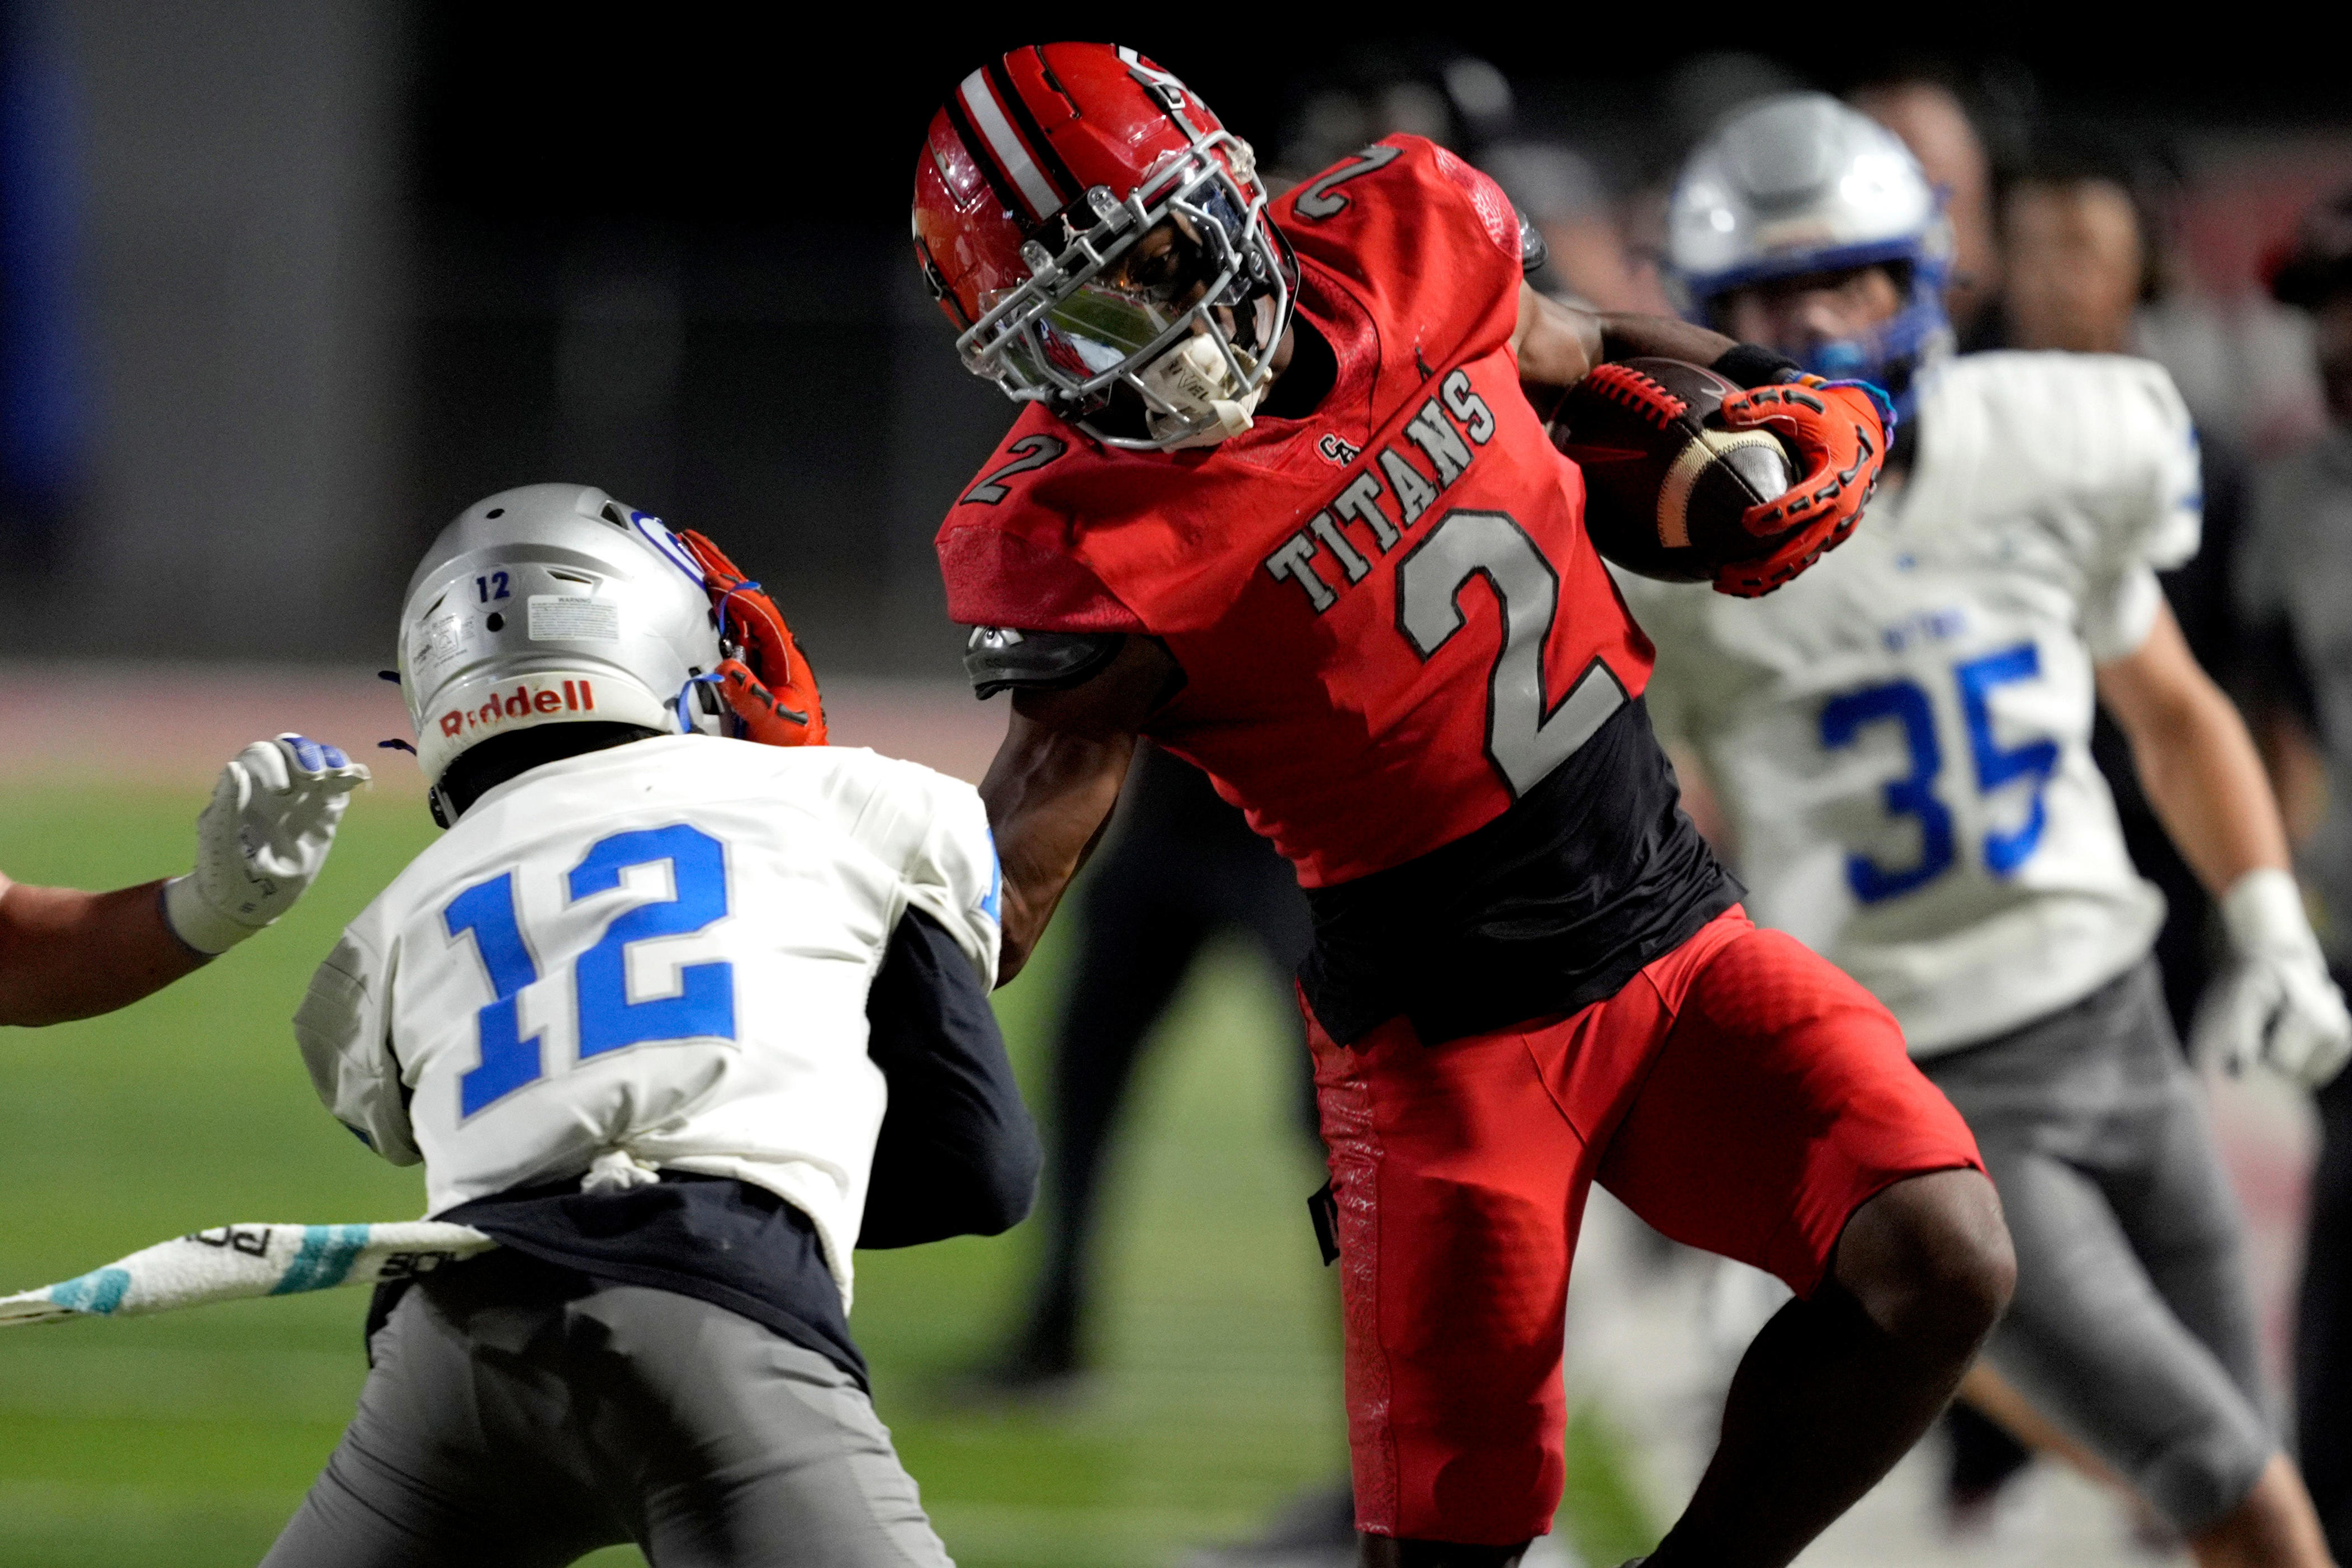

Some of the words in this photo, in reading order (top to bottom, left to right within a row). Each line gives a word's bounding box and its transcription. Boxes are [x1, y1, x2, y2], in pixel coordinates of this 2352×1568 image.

[1294, 143, 1405, 221] 2
[476, 571, 510, 603] 12
[959, 434, 1068, 506] 2
[1265, 369, 1497, 613] TITANS
[1394, 506, 1632, 806] 2
[1817, 640, 2060, 907] 35
[439, 821, 741, 1129] 12
